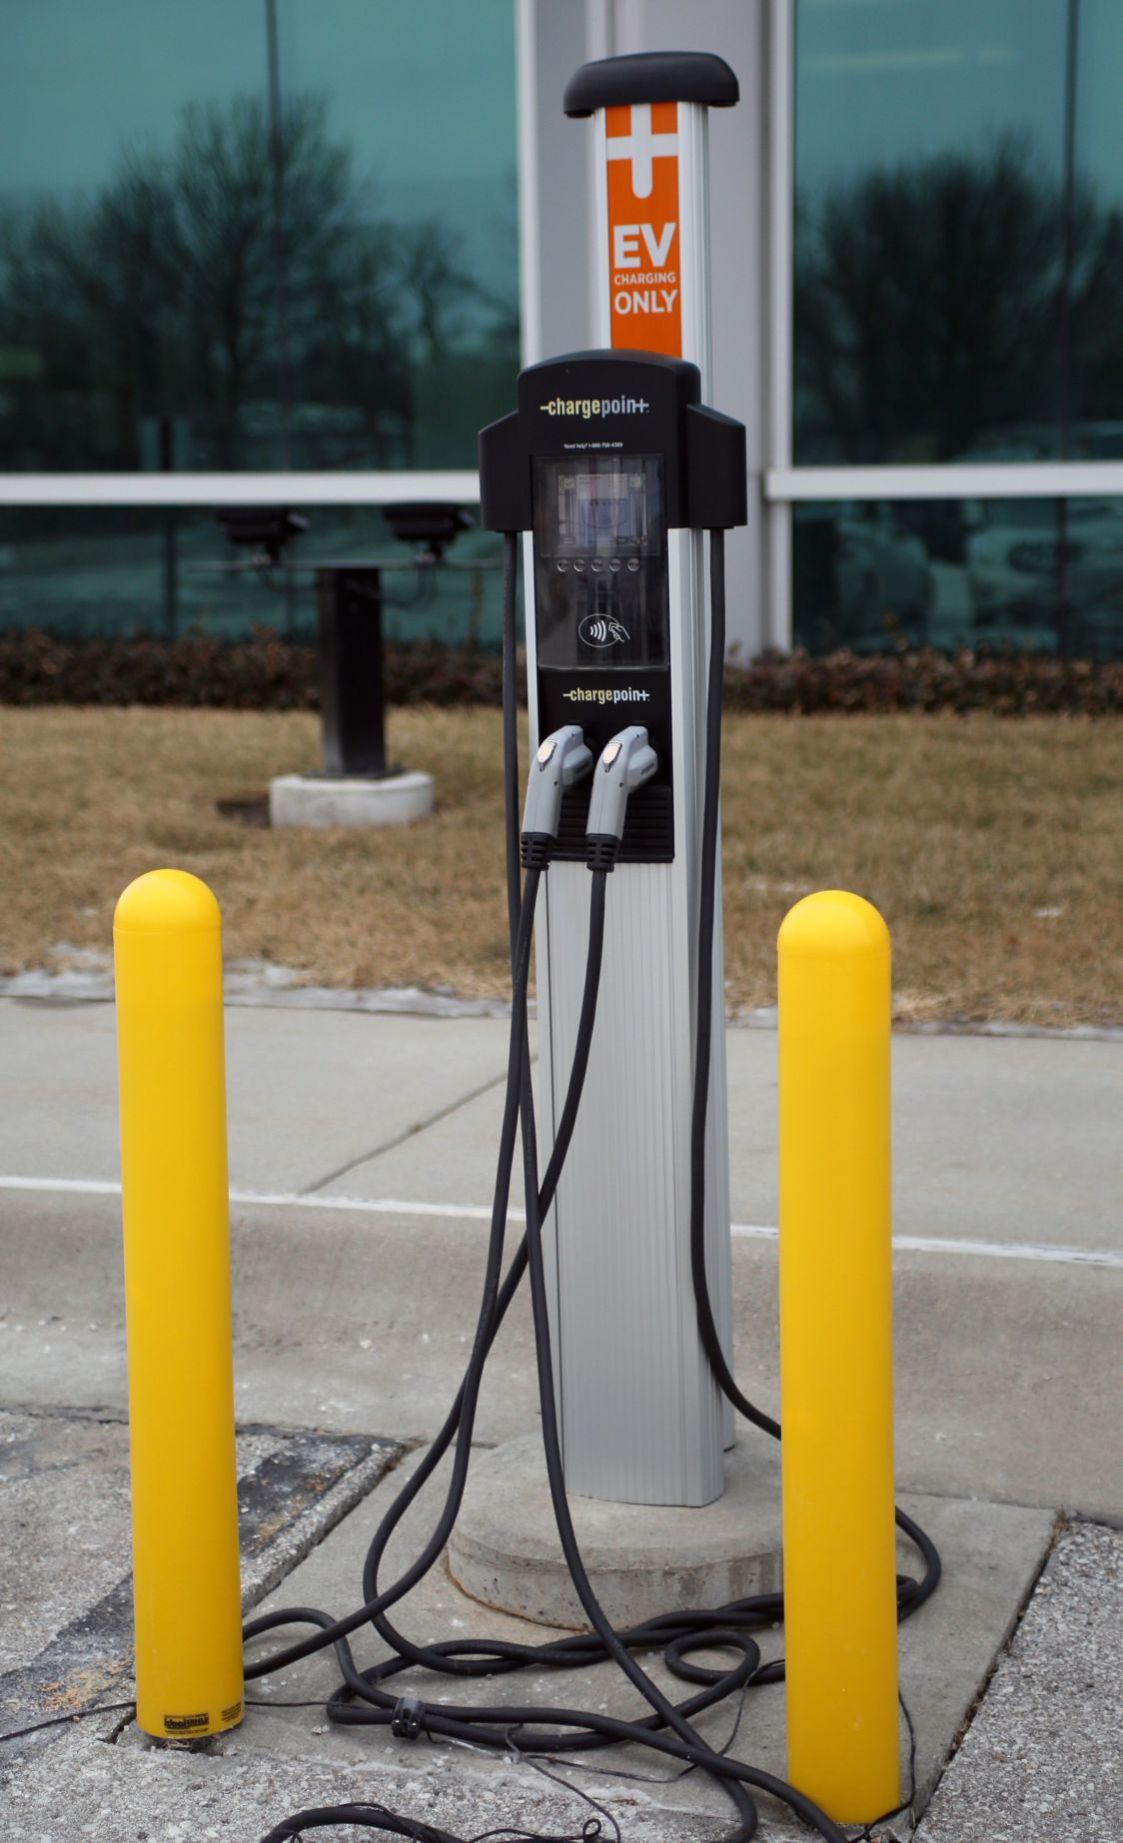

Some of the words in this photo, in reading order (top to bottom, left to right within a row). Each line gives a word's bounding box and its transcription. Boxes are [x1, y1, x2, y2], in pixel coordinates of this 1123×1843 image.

[613, 222, 677, 269] EV
[614, 271, 677, 286] CHARGING
[614, 289, 678, 315] ONLY
